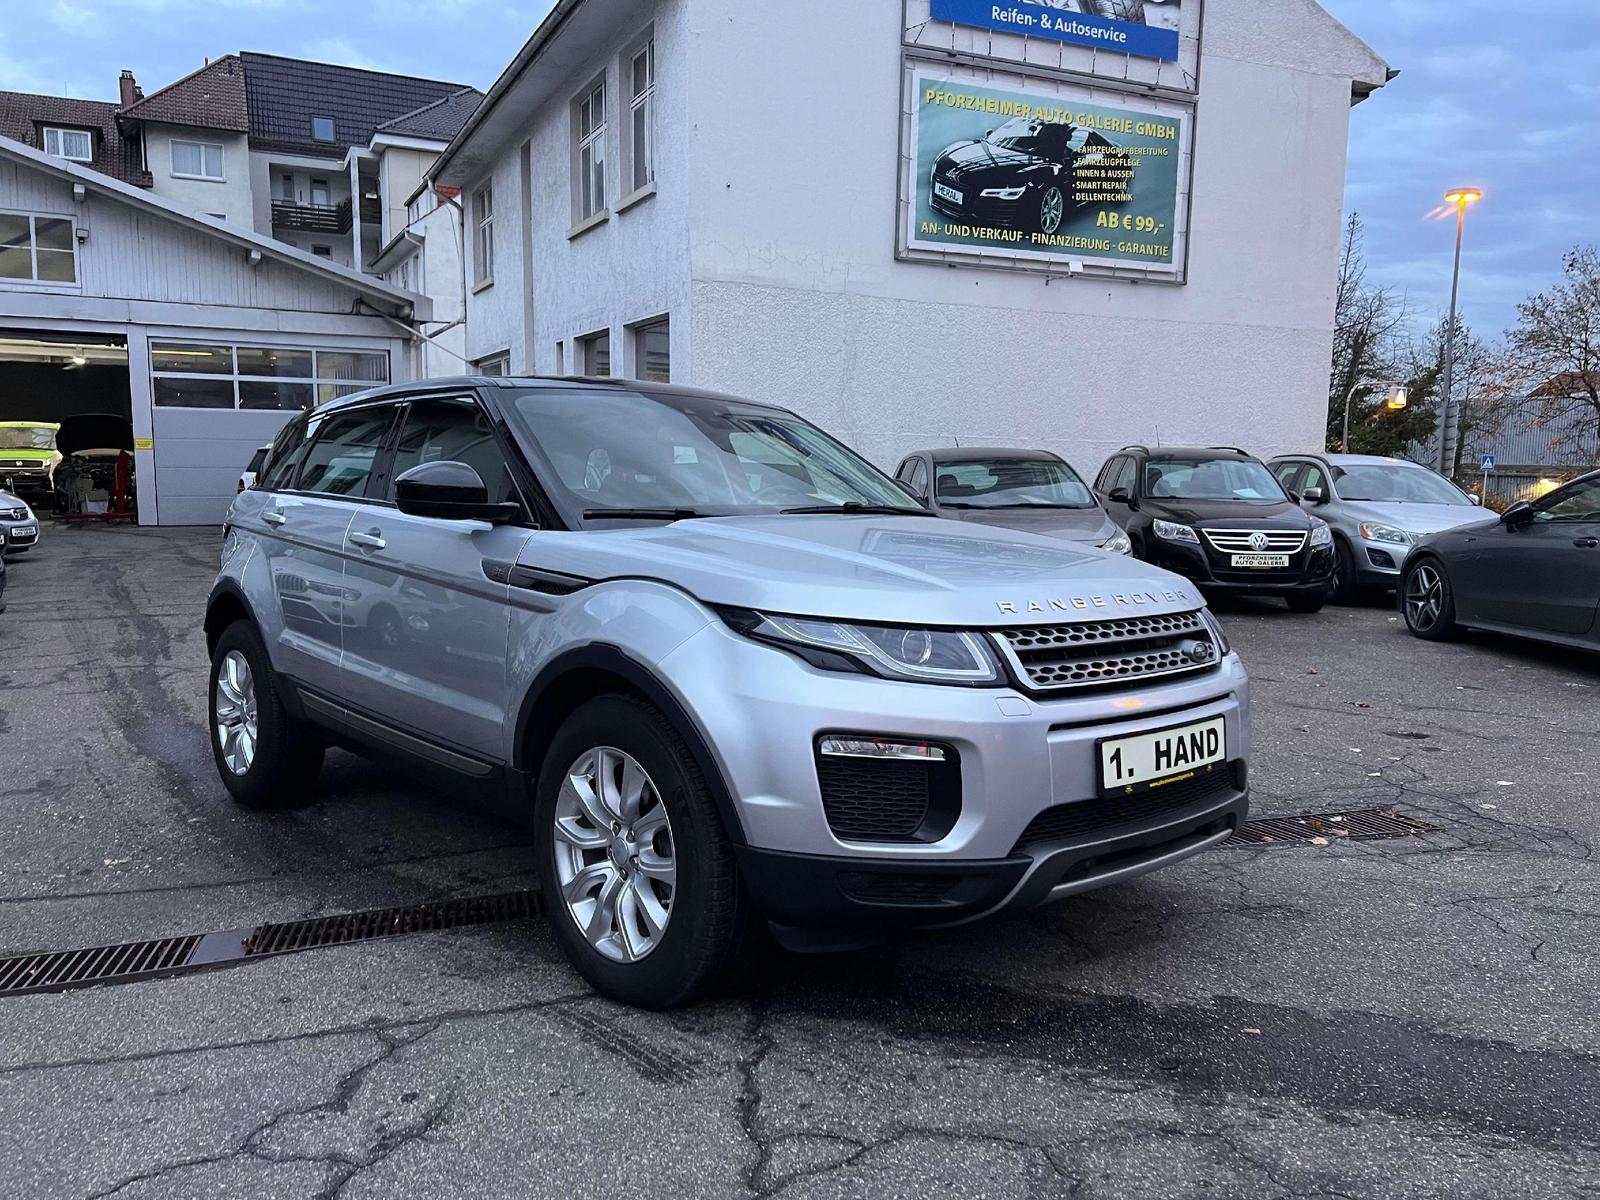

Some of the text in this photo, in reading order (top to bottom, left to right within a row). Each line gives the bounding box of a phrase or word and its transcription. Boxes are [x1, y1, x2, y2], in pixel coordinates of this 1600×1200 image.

[992, 6, 1127, 43] Reifen- & Autoservice
[926, 89, 1175, 140] PFORZHEIMER AUTO GALERIE GMBH
[1078, 145, 1169, 156] FAHRZEUGAUFBEREITUNG
[1076, 157, 1142, 167] FAHRZEUGPFLEGE
[1077, 169, 1099, 178] INNEN
[1107, 170, 1135, 178] AUSSEN
[1076, 181, 1127, 190] SMART REPAIR
[1075, 193, 1133, 201] DELLENTECHNIK
[1096, 211, 1119, 228] AB
[1122, 214, 1133, 230] €
[921, 222, 942, 234] AN-
[944, 224, 971, 237] UND
[972, 226, 1023, 242] VERKAUF
[1031, 233, 1110, 251] FINANZIERUNG
[1118, 241, 1169, 256] GARANTIE
[996, 590, 1188, 614] RANGE ROVER
[1110, 727, 1219, 779] 1. HAND
